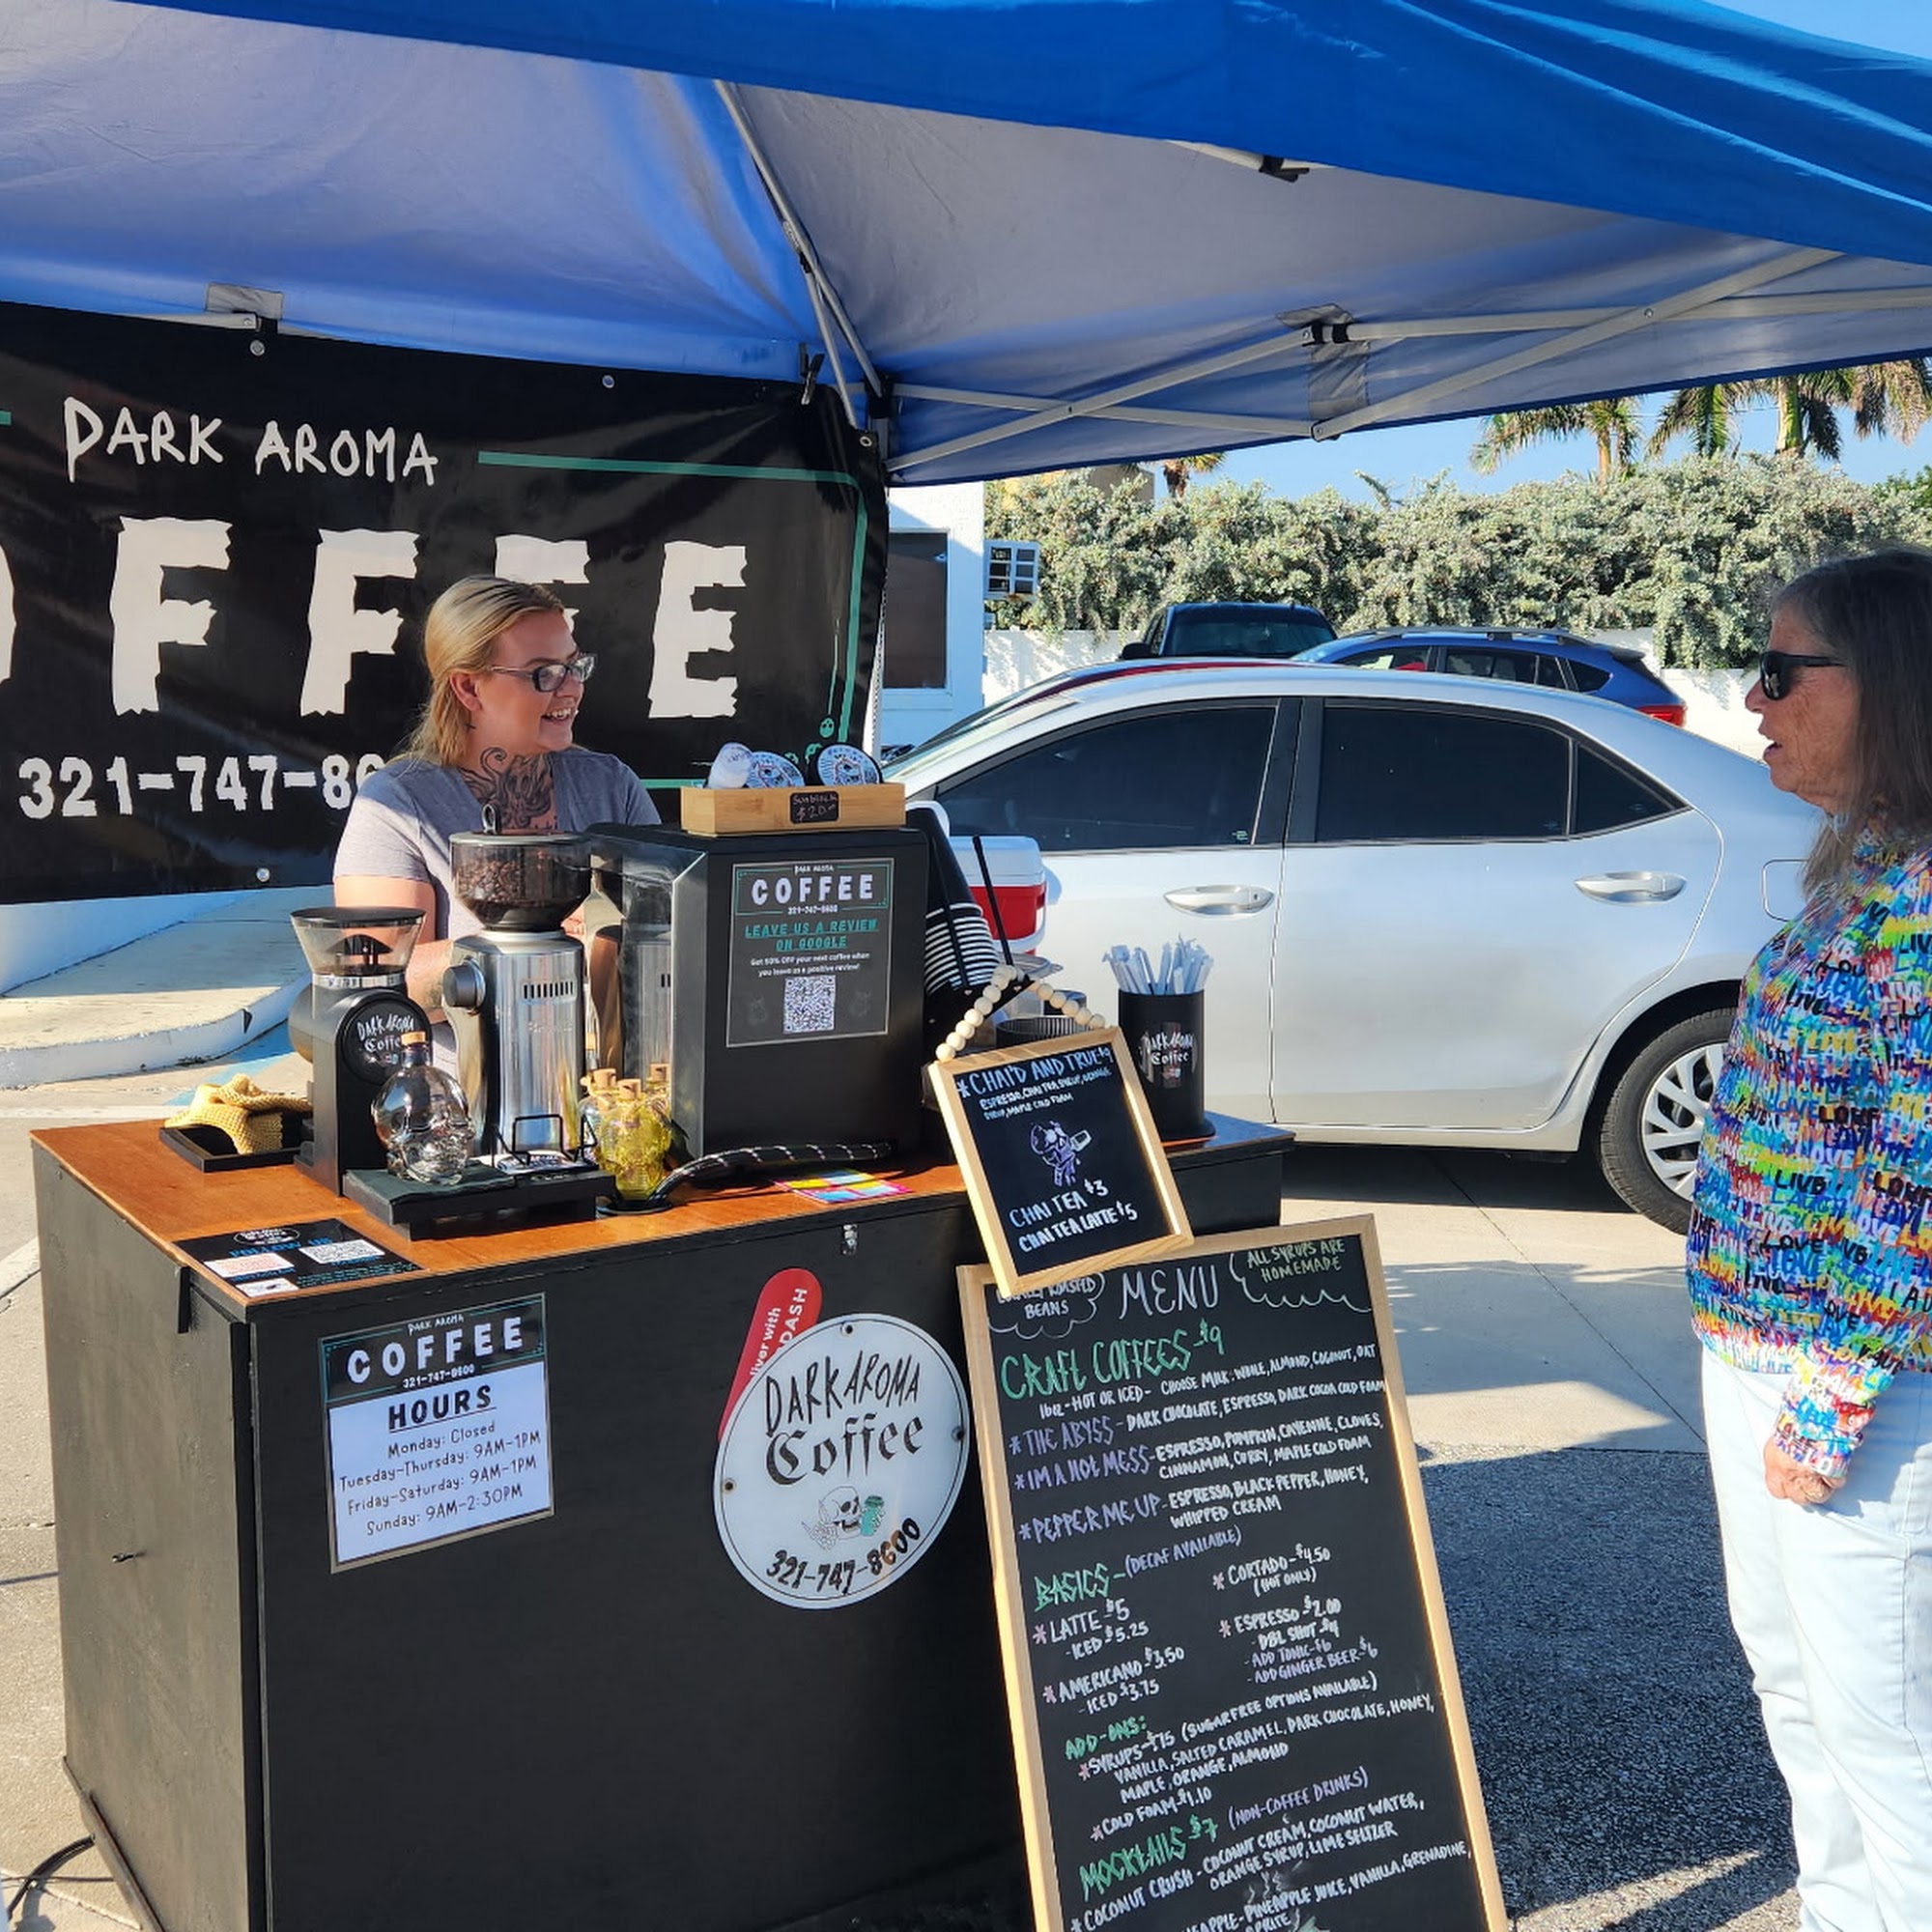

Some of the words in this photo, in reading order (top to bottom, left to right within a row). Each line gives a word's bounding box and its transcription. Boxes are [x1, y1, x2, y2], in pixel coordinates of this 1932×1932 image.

[64, 397, 224, 483] DARK
[255, 421, 439, 486] AROMA
[0, 515, 747, 718] FFE
[752, 874, 873, 905] COFFEE
[745, 923, 788, 938] LEAVE
[794, 922, 810, 935] US
[815, 921, 825, 934] A
[831, 919, 878, 933] REVIEW
[776, 939, 793, 952] ON
[799, 936, 848, 952] GOOGLE
[1032, 1056, 1064, 1081] AND
[1009, 1203, 1052, 1228] CHAI
[1051, 1190, 1088, 1213] TEA
[1084, 1179, 1109, 1197] $3
[1054, 1219, 1083, 1239] TEA
[1247, 1251, 1270, 1269] ALL
[1271, 1242, 1317, 1262] SYRUPS
[1320, 1238, 1346, 1255] ARE
[1261, 1256, 1342, 1283] HOMEMADE
[1024, 1299, 1069, 1320] BEANS
[1119, 1264, 1218, 1320] MENU
[762, 1307, 781, 1342] with
[346, 1316, 524, 1384] COFFEE
[1093, 1328, 1192, 1384] COFFEES
[1099, 1388, 1117, 1405] OR
[1160, 1377, 1199, 1396] CHOOSE
[1356, 1343, 1376, 1358] OAT
[388, 1384, 493, 1431] HOURS
[766, 1355, 842, 1438] DARK
[842, 1350, 921, 1408] AROMA
[1023, 1428, 1058, 1457] THE
[1061, 1415, 1115, 1450] ABYSS
[1126, 1410, 1161, 1432] DARK
[1277, 1384, 1309, 1404] DARK
[1338, 1380, 1358, 1395] COLD
[387, 1435, 447, 1460] Monday:
[450, 1421, 496, 1444] Closed
[765, 1412, 924, 1486] Coffee
[1274, 1443, 1315, 1463] MAPLE
[1313, 1441, 1337, 1457] COLD
[1337, 1435, 1372, 1452] FOAM
[339, 1450, 469, 1492] Tuesday-Thursday:
[473, 1430, 541, 1459] 9AM-1PM
[1055, 1463, 1067, 1487] A
[348, 1477, 465, 1516] Friday-Saturday:
[469, 1455, 537, 1485] 9AM-1PM
[367, 1513, 421, 1536] Sunday:
[425, 1483, 524, 1520] 9AM-2:30PM
[1032, 1505, 1103, 1545] PEPPER
[1101, 1499, 1135, 1528] ME
[1232, 1477, 1275, 1499] BLACK
[1170, 1505, 1230, 1530] WHIPPED
[1232, 1494, 1282, 1517] CREAM
[766, 1517, 922, 1596] 321-747-8600
[1227, 1556, 1289, 1585] CORTADO
[1035, 1562, 1110, 1612] BASICS
[1050, 1609, 1103, 1643] LATTE
[1234, 1607, 1300, 1634] ESPRESSO
[1287, 1621, 1318, 1641] SHOT
[1058, 1660, 1144, 1703] AMERICANO
[1278, 1655, 1326, 1681] GINGER
[1327, 1647, 1360, 1668] BEER
[1088, 1743, 1144, 1776] SYRUPS
[1264, 1689, 1312, 1709] OPTIONS
[1172, 1744, 1218, 1768] SALTED
[1287, 1714, 1322, 1734] DARK
[1232, 1742, 1289, 1769] ALMOND
[1101, 1811, 1134, 1836] COLD
[1136, 1800, 1179, 1823] FOAM
[1083, 1886, 1146, 1932] COCONUT
[1149, 1867, 1195, 1899] CRUSH
[1202, 1841, 1255, 1874] COCONUT
[1309, 1808, 1367, 1833] COCONUT
[1209, 1856, 1265, 1890] ORANGE
[1243, 1889, 1312, 1923] PINEAPPLE
